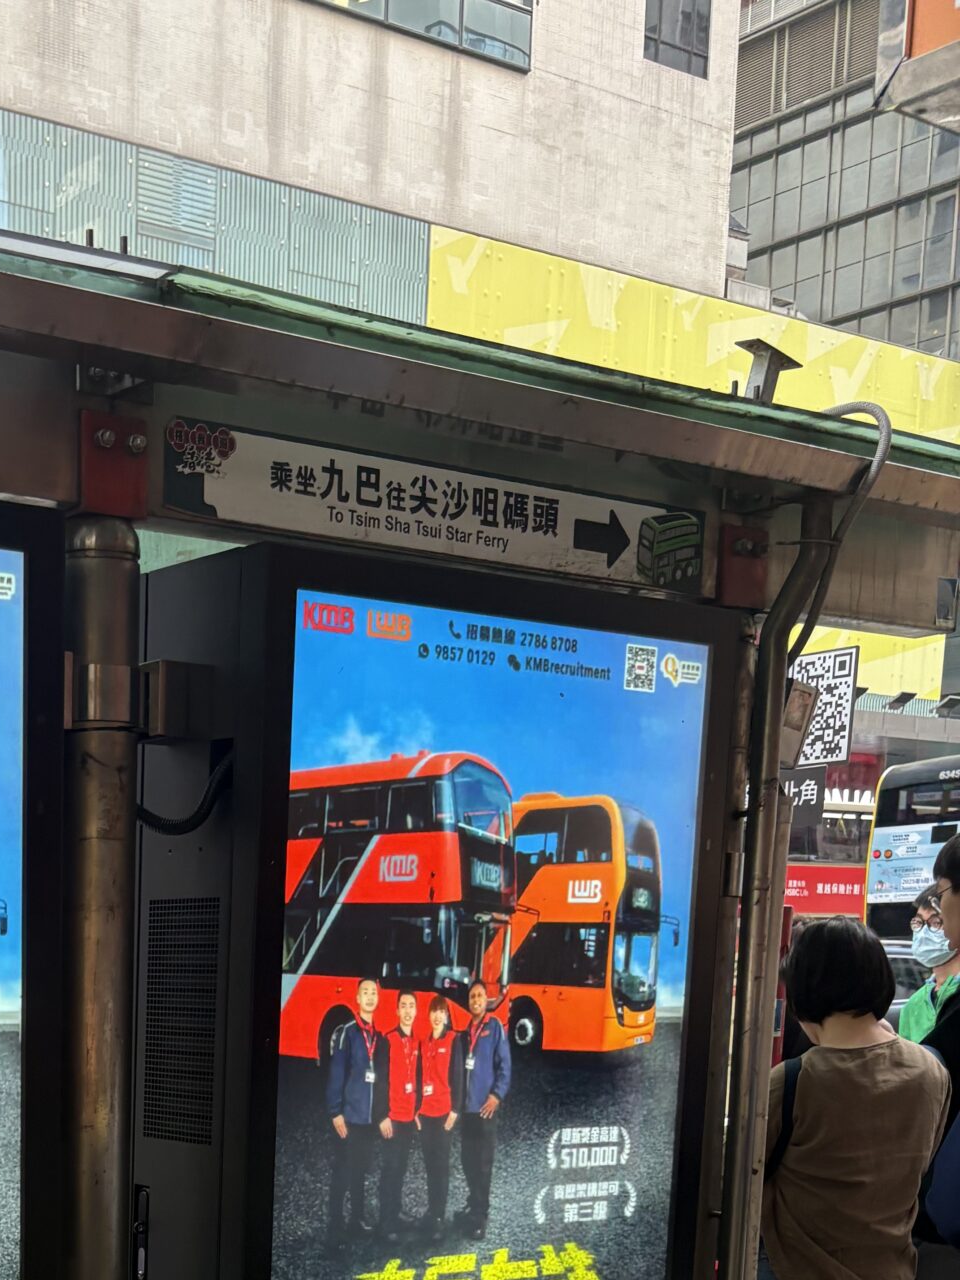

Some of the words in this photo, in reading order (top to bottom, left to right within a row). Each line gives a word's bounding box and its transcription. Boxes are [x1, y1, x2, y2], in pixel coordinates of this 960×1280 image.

[270, 458, 559, 538] 乘坐九巴往尖沙咀碼頭
[327, 505, 344, 524] To
[348, 508, 381, 530] Tsim
[384, 516, 411, 535] Sha
[414, 519, 442, 540] Tsui
[445, 528, 473, 545] Star
[475, 531, 510, 553] Ferry
[302, 599, 355, 636] KMB
[366, 608, 413, 642] LWB
[434, 644, 464, 662] 9857
[467, 648, 496, 667] 0129
[520, 632, 548, 650] 2786
[550, 636, 578, 654] 8708
[525, 655, 612, 681] KMBrecruitment
[378, 854, 419, 882] KMB
[567, 879, 602, 904] LWB
